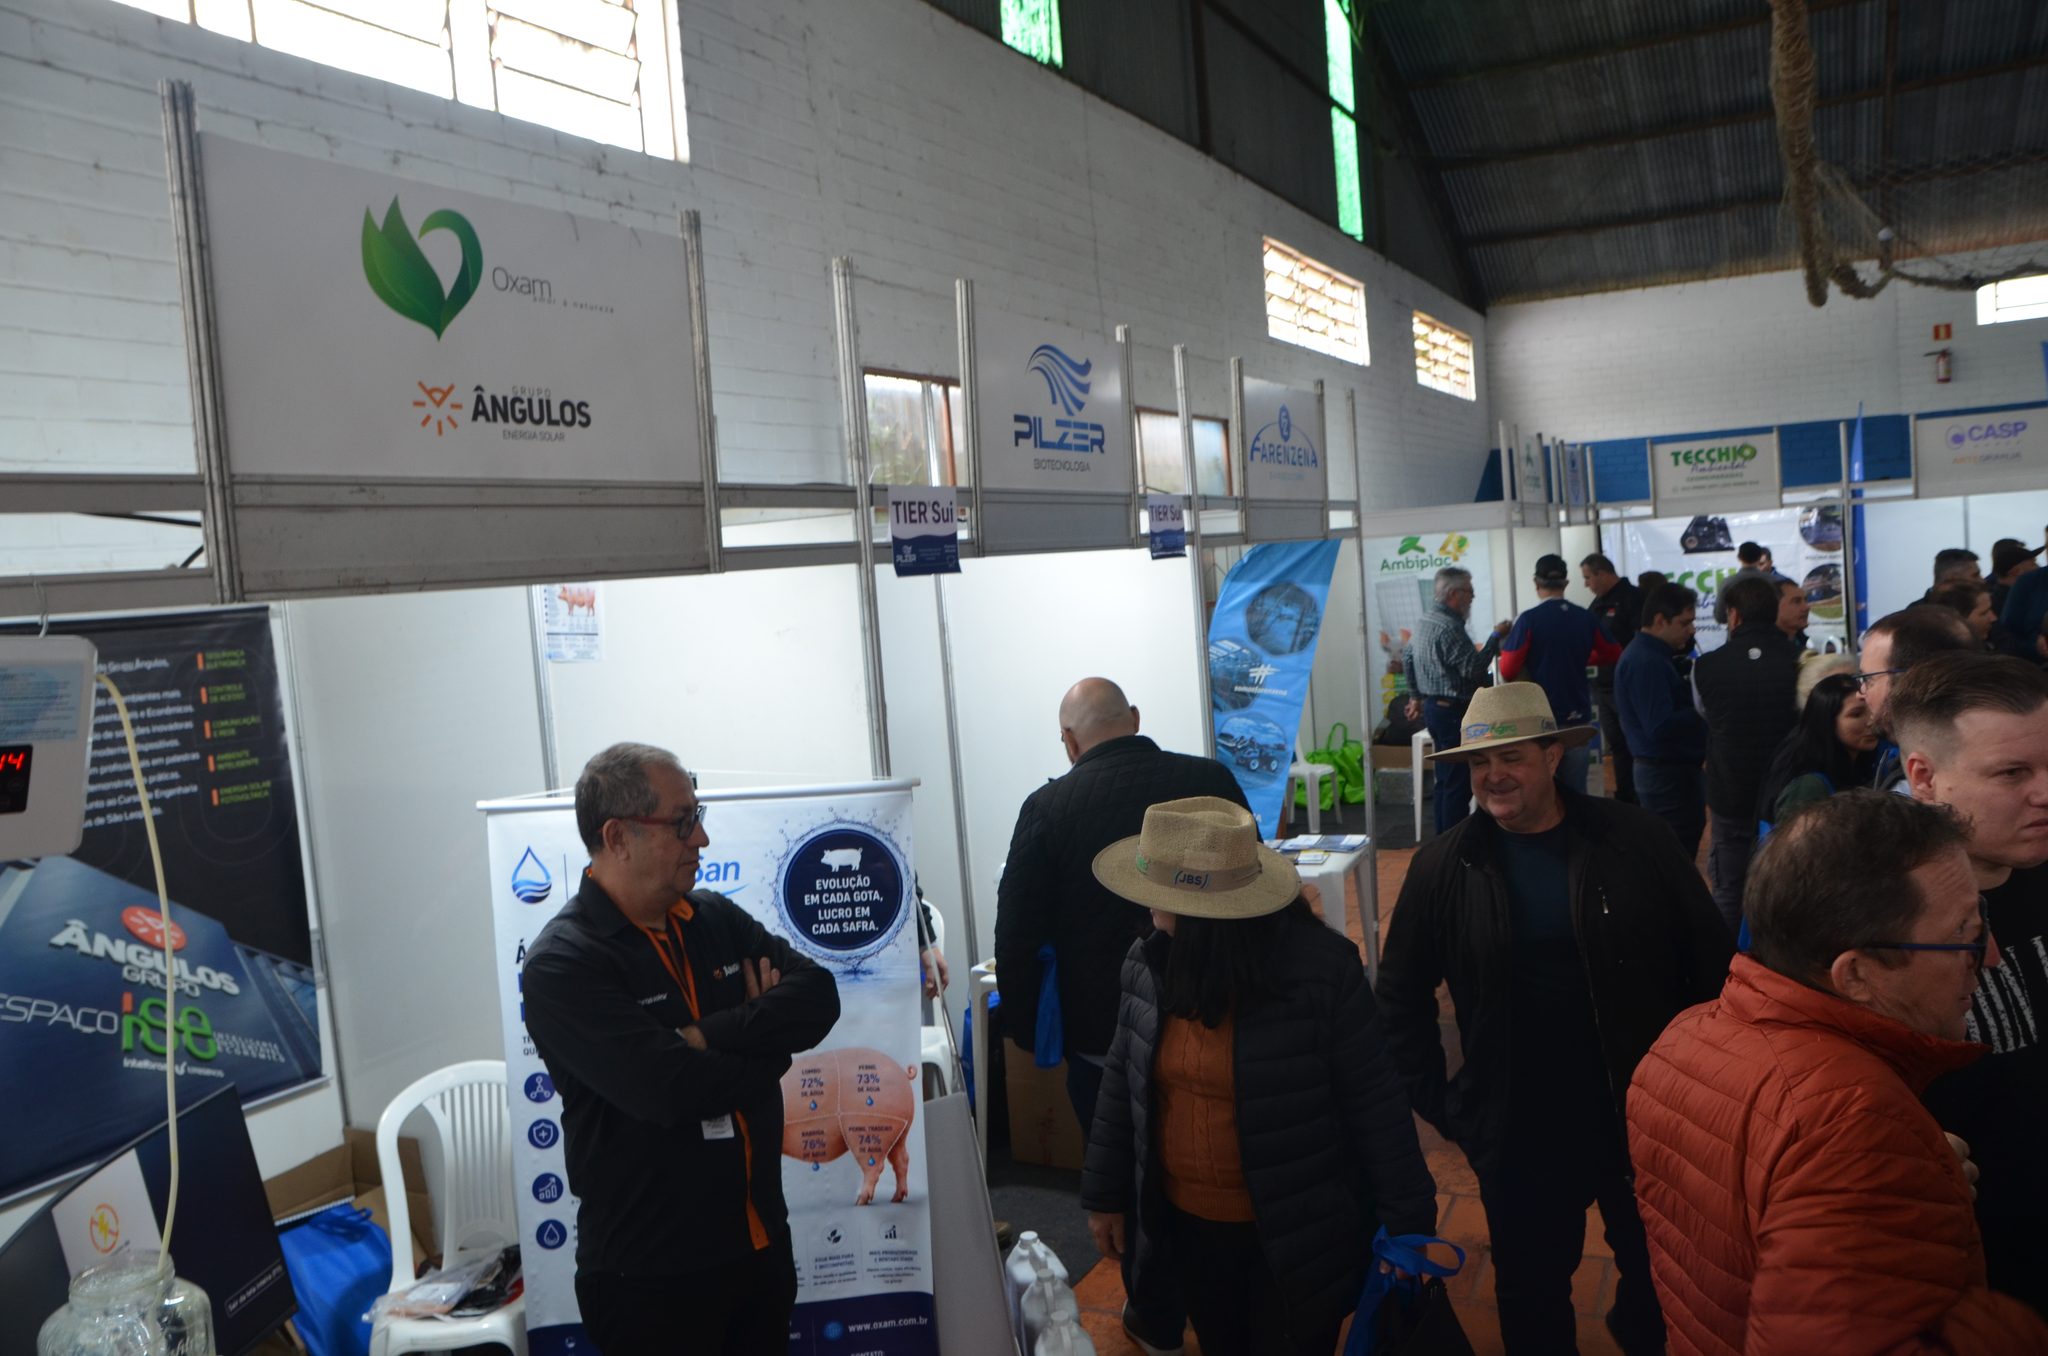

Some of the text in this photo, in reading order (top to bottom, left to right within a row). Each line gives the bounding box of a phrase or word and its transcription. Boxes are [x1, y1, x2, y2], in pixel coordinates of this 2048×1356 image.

[492, 266, 552, 297] Oxam
[512, 385, 551, 398] GRUPO
[472, 384, 591, 428] ÂNGULOS
[502, 429, 565, 441] ENERGIA SOLAR
[1014, 414, 1105, 454] PILZER
[1968, 421, 2028, 441] CASP
[1250, 434, 1318, 468] FARENZENA
[1671, 443, 1757, 467] TECCHIO
[1033, 459, 1091, 472] BIOTECNOLOGIA
[892, 501, 954, 524] TIER Sui
[1381, 555, 1452, 571] Ambiplac
[694, 855, 740, 883] San
[816, 874, 870, 891] EVOLUÇÃO
[804, 891, 883, 906] EM CADA GOTA,
[818, 906, 870, 920] LUCRO EM
[812, 920, 879, 935] CADA SAFRA.
[49, 919, 240, 995] ÂNGULOS
[801, 1078, 824, 1088] 72%
[857, 1073, 880, 1084] 73%
[859, 1134, 881, 1145] 74%
[848, 1315, 928, 1333] www.oxam.com.br
